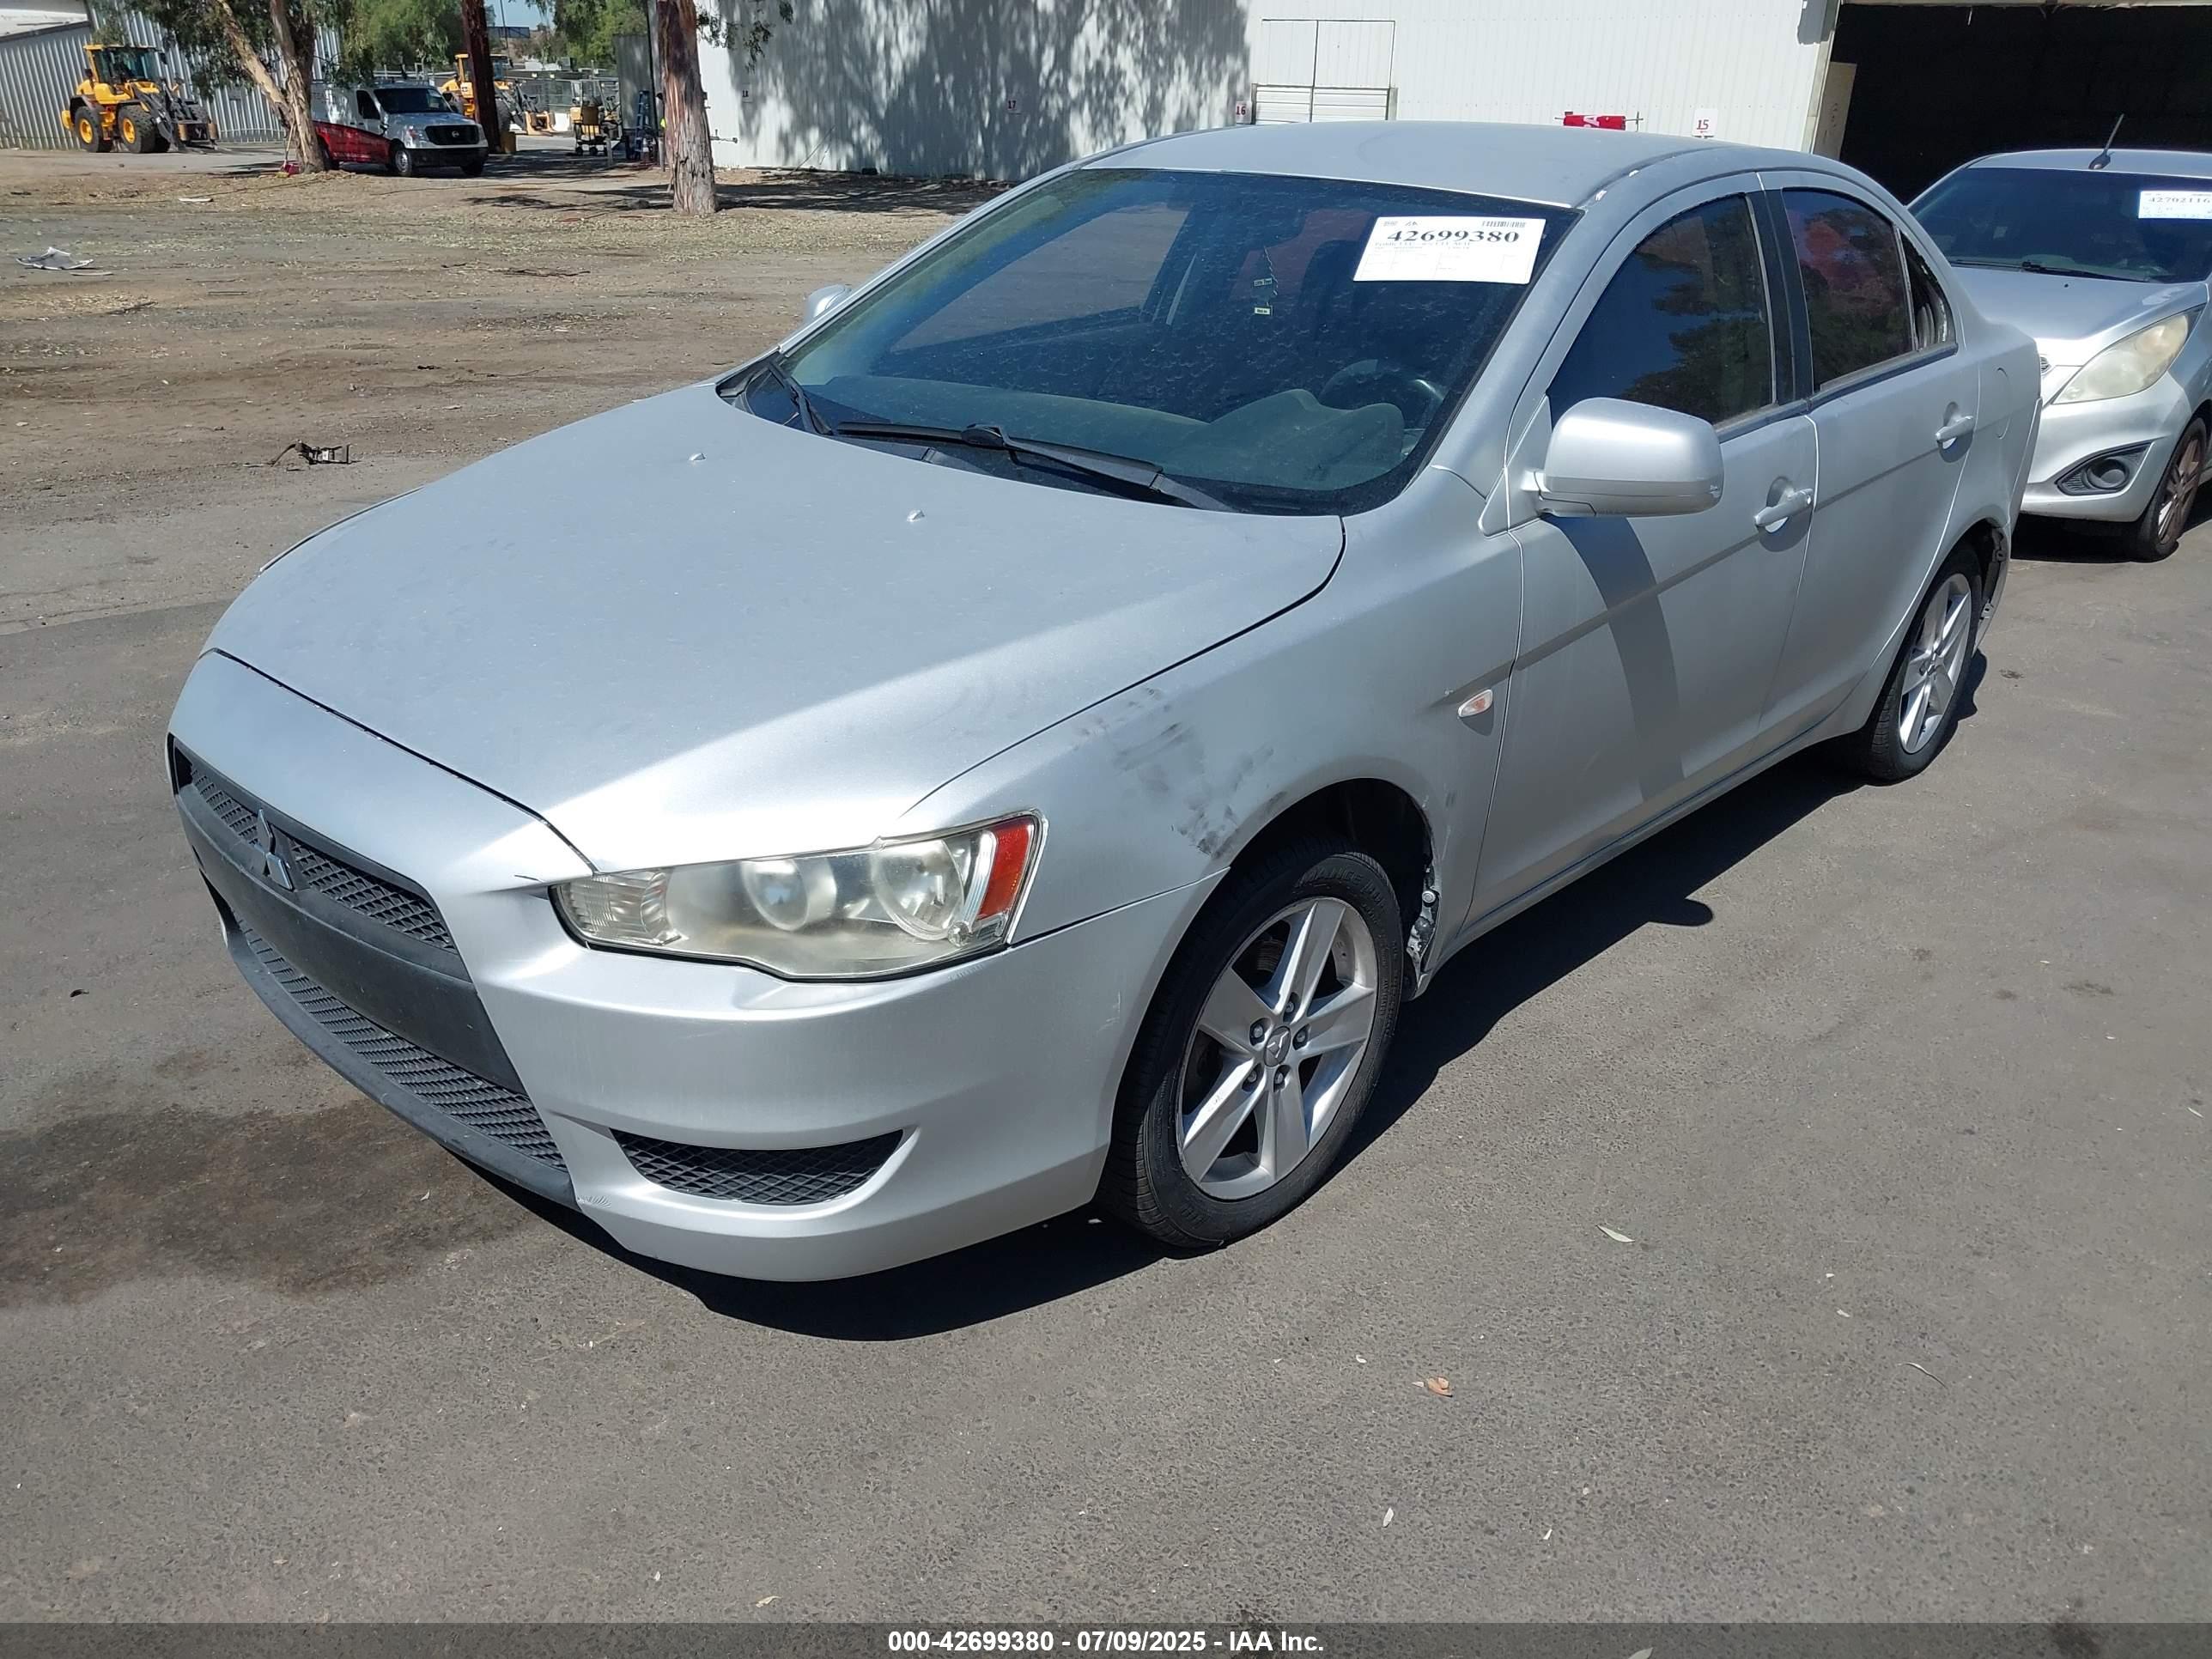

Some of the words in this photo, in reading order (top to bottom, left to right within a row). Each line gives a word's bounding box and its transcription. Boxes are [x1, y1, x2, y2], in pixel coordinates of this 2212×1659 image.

[1008, 100, 1017, 109] 17
[1236, 106, 1246, 115] 16
[1697, 119, 1709, 130] 15
[1388, 230, 1519, 243] 42699380
